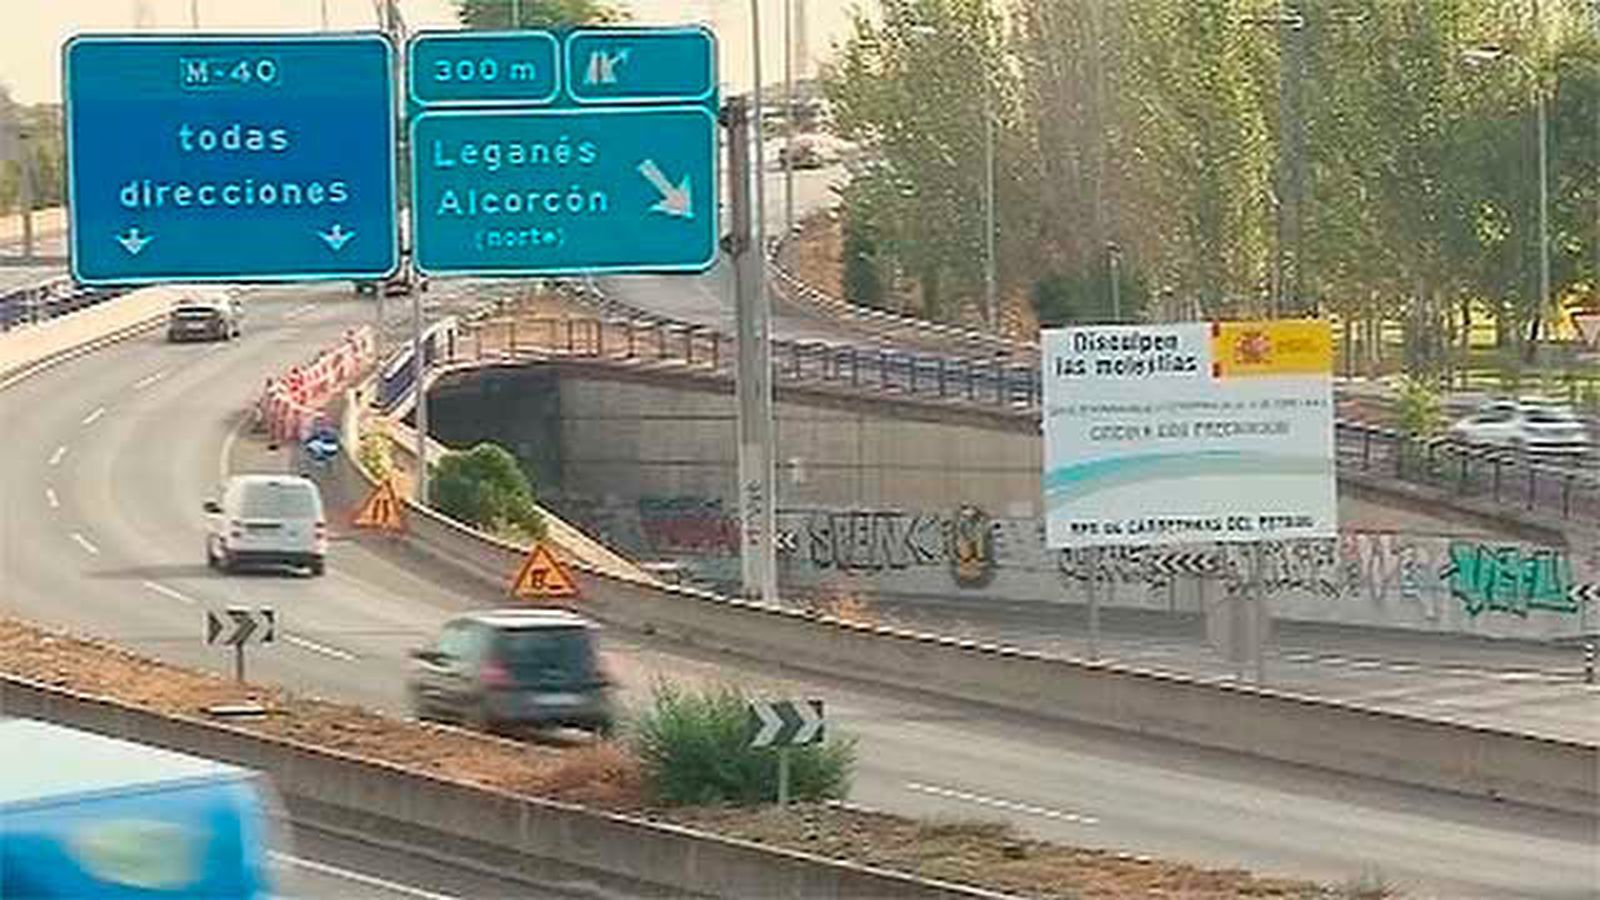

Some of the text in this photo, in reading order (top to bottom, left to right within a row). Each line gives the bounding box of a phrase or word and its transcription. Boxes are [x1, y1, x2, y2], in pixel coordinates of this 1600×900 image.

[185, 58, 277, 84] M-40
[433, 58, 536, 82] 300 m
[178, 122, 290, 152] todas
[433, 135, 598, 170] Leganés
[118, 177, 349, 208] direcciones
[436, 184, 609, 216] Alcorcón
